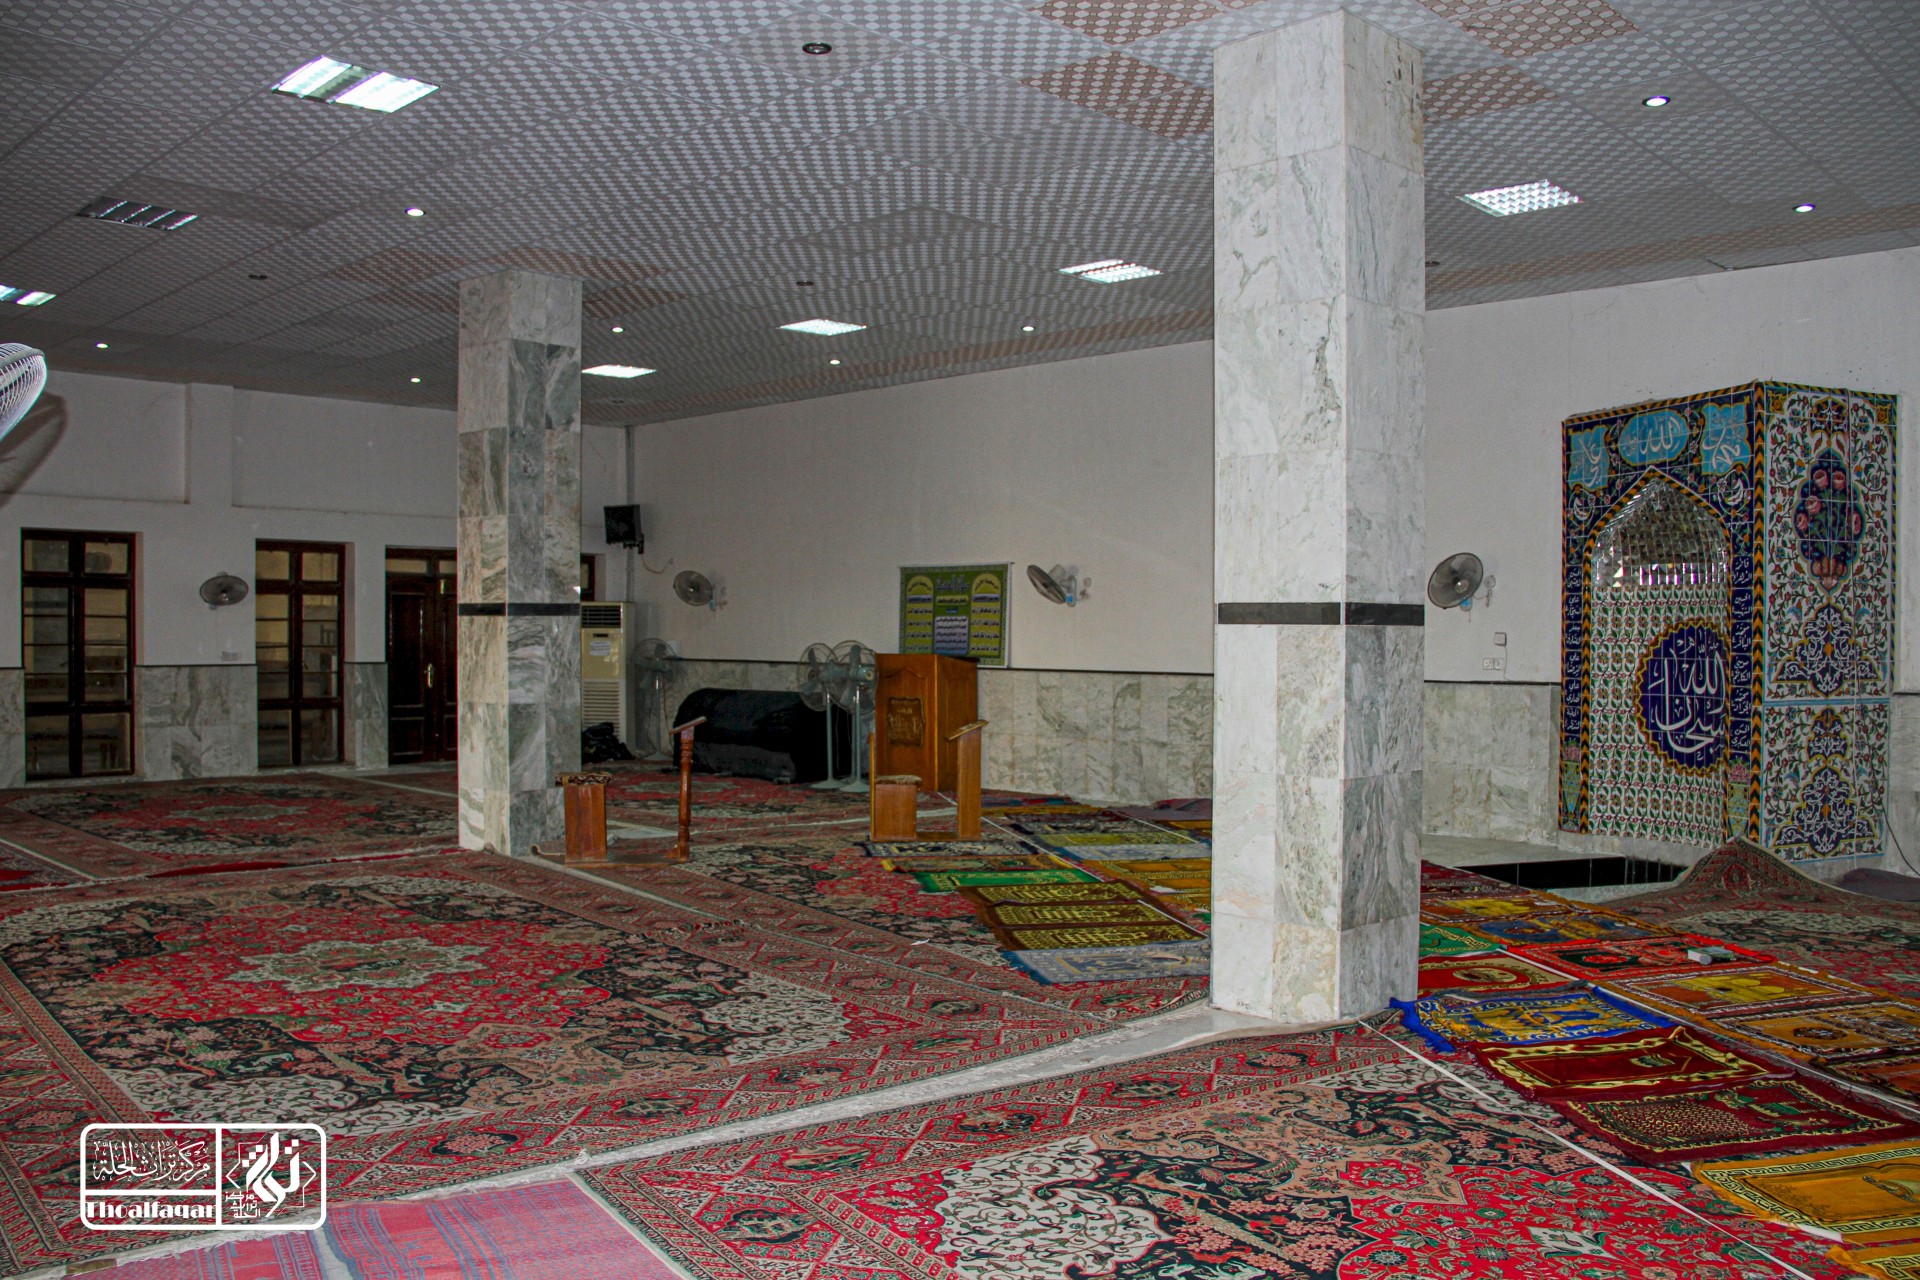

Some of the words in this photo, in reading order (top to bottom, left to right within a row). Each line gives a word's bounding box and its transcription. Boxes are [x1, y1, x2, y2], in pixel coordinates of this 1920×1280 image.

[1639, 416, 1681, 455] الله
[1702, 427, 1740, 470] محمد
[1578, 436, 1602, 487] علي
[1569, 595, 1580, 604] علي
[1735, 623, 1750, 636] محمد
[1569, 652, 1581, 662] علي
[1569, 680, 1581, 690] علي
[1733, 688, 1750, 702] محمد
